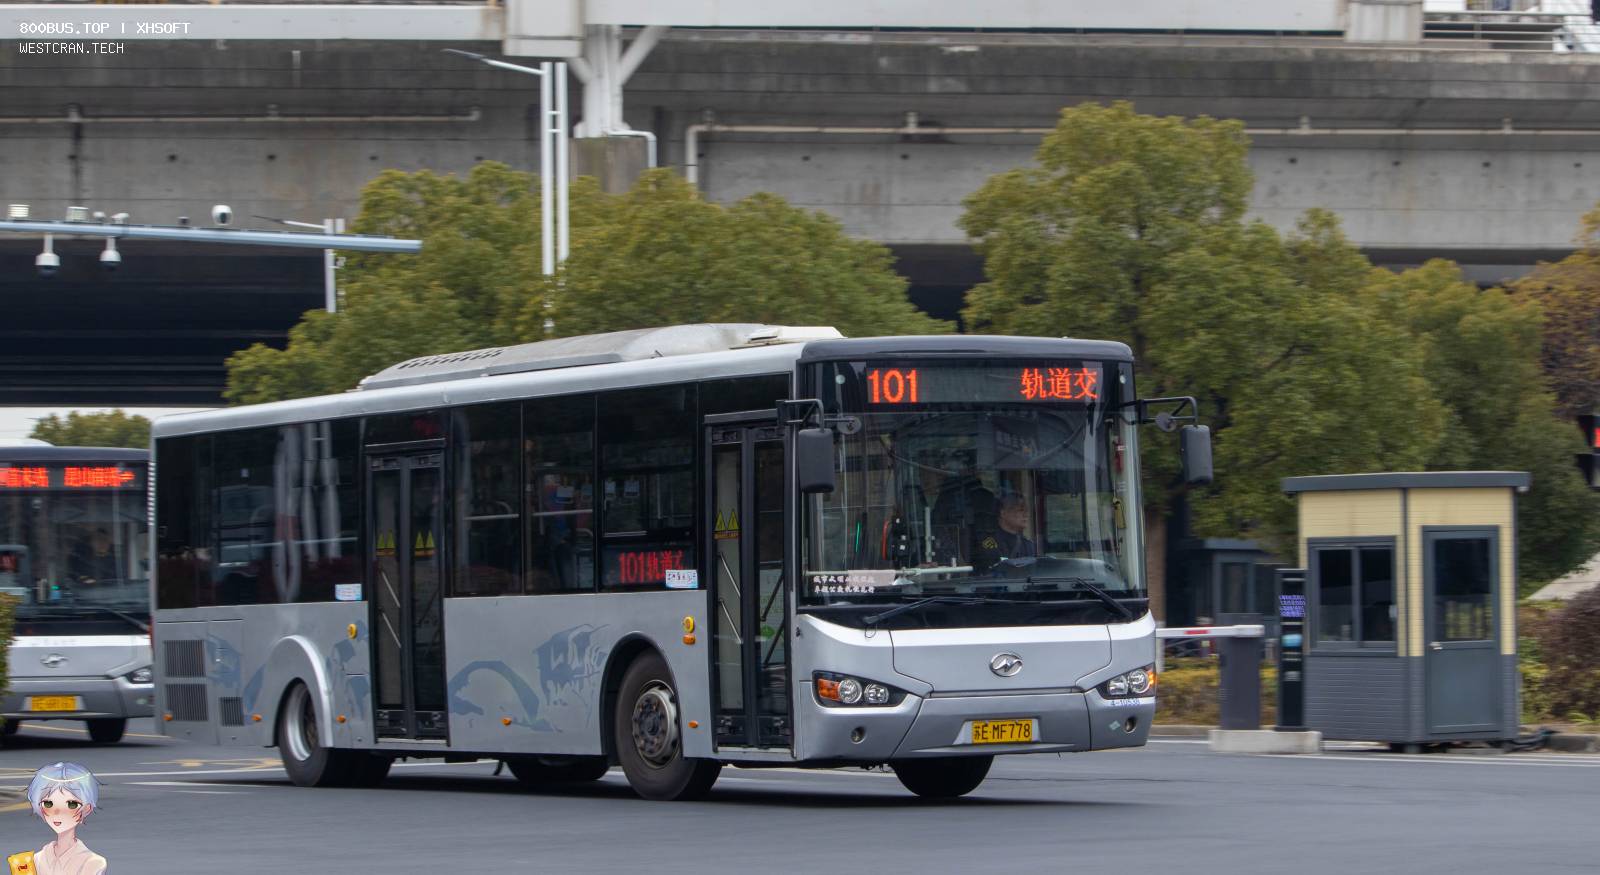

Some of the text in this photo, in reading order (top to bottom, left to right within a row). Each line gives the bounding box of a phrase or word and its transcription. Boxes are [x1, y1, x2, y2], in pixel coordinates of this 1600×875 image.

[867, 367, 1099, 403] 101 轨道交
